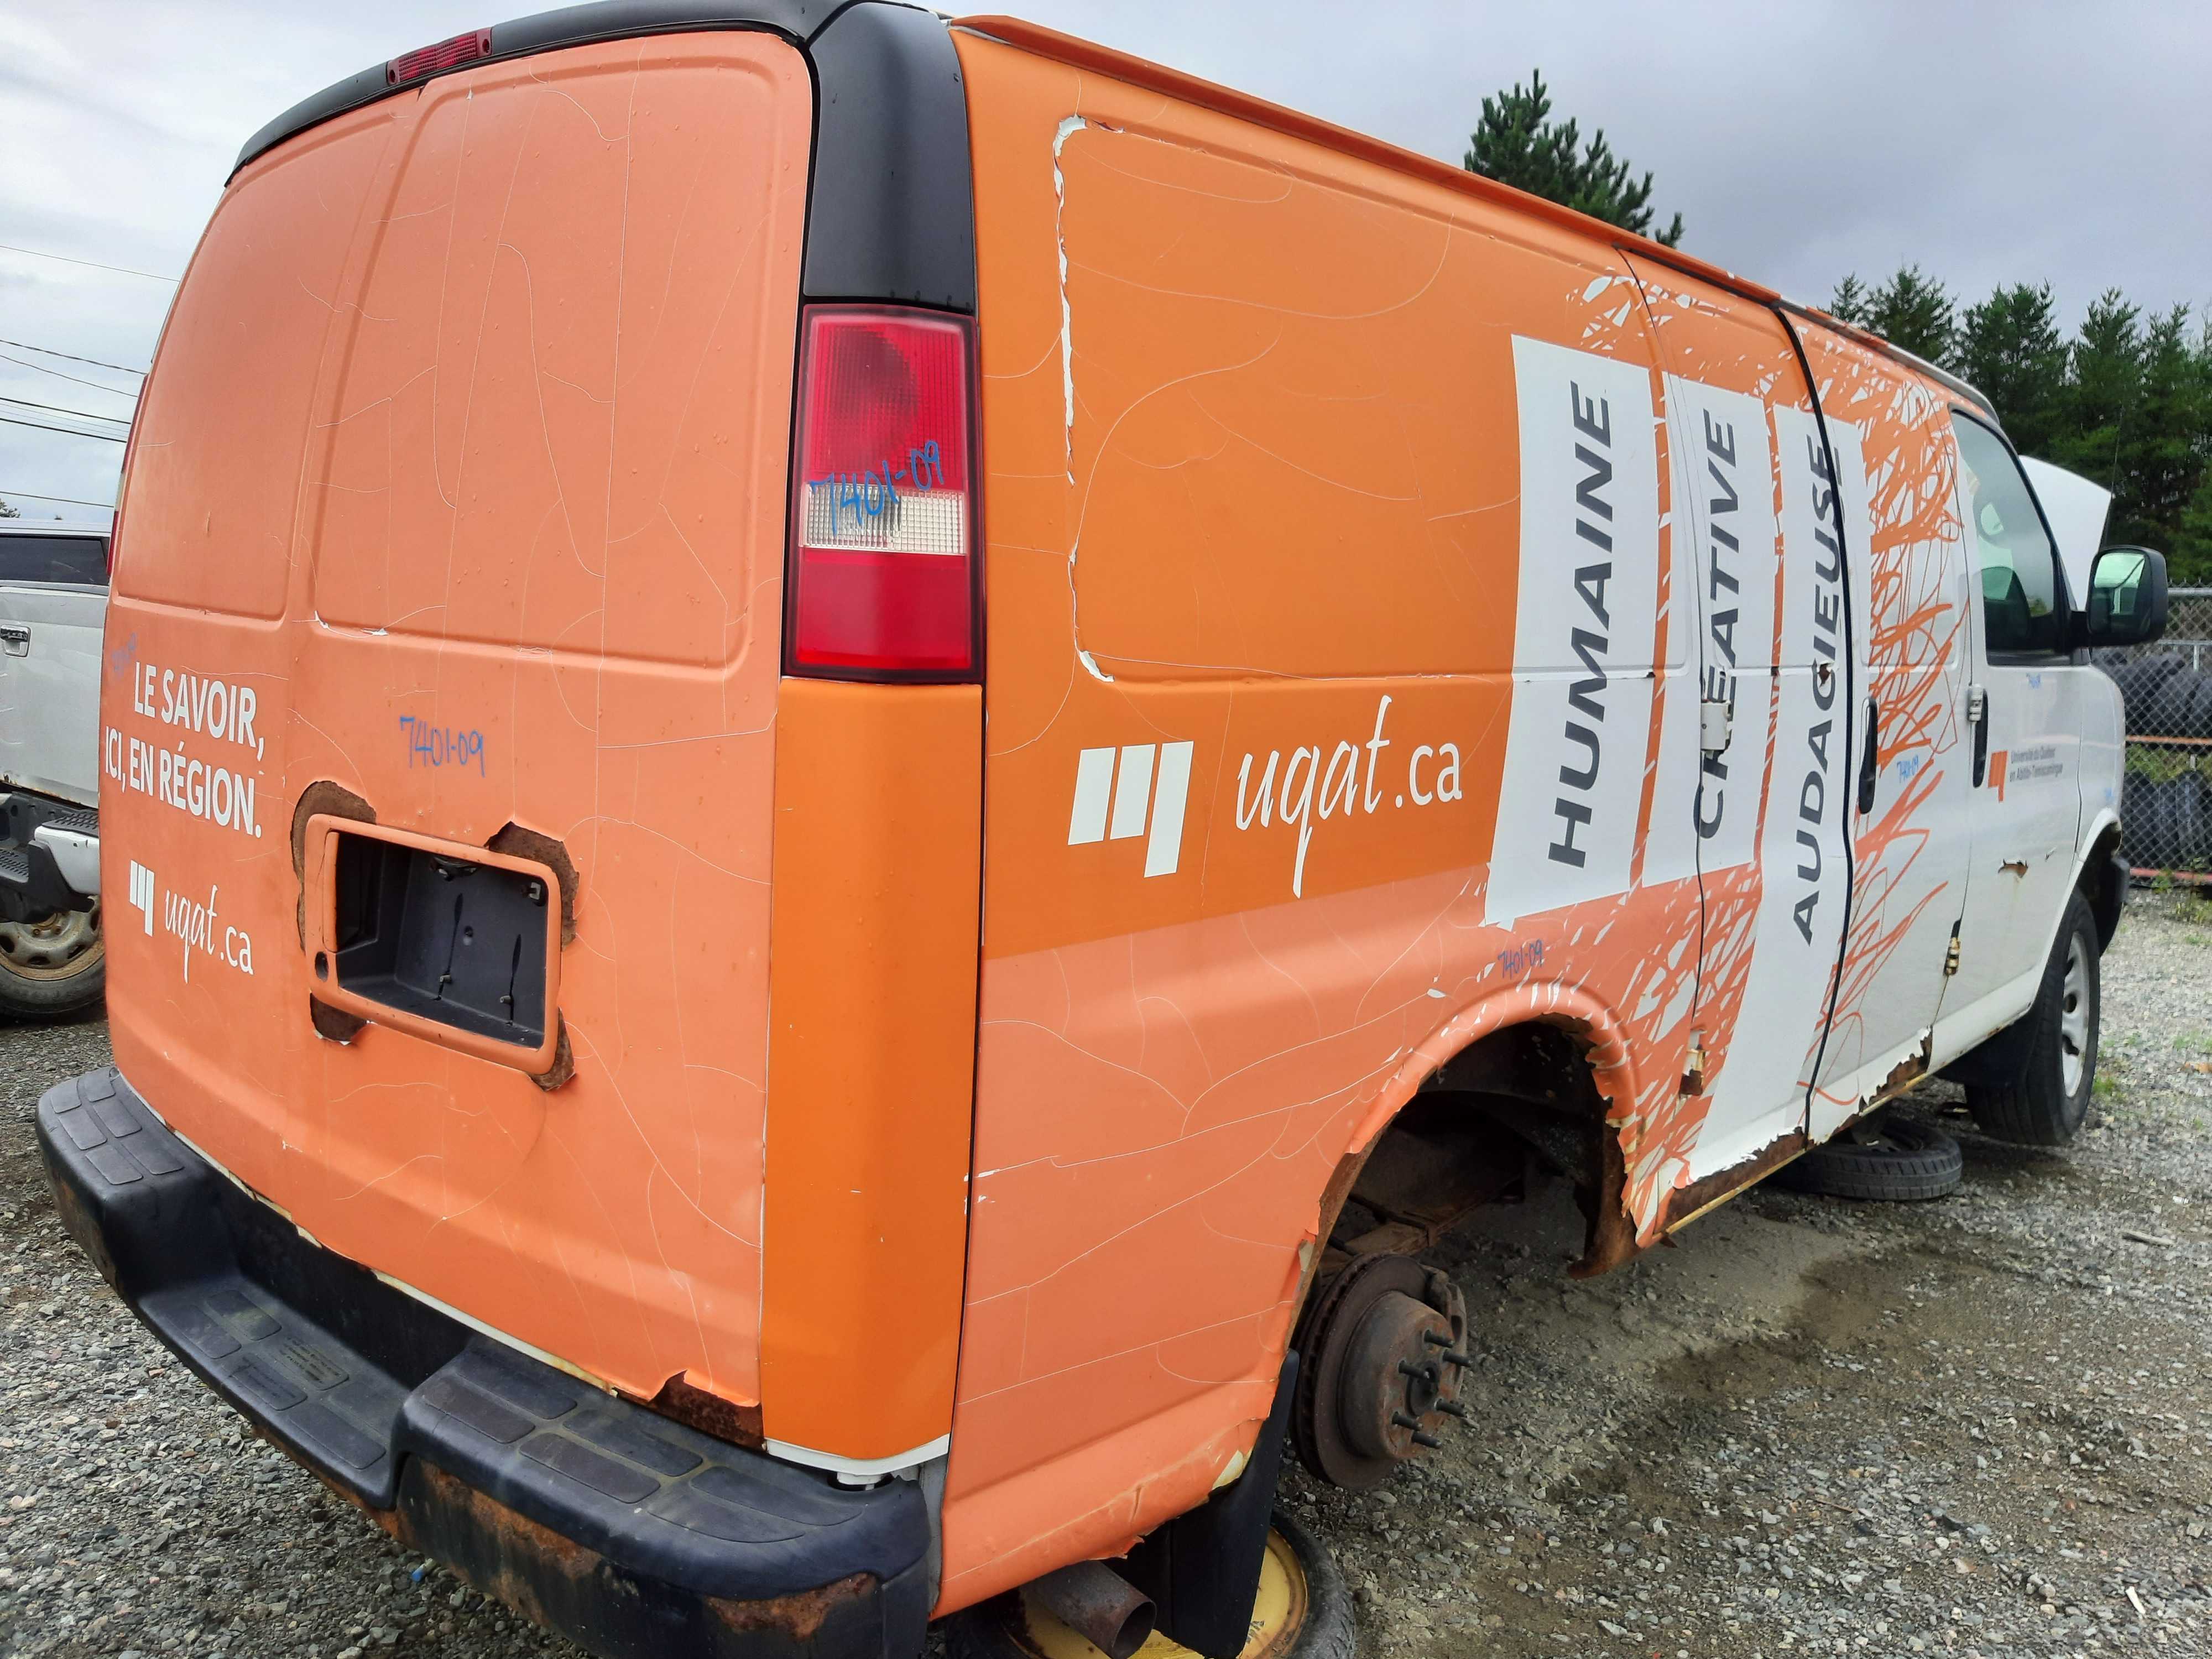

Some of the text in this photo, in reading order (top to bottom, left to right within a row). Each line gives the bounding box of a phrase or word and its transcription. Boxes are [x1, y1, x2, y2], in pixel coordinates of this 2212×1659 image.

[809, 440, 944, 536] 7401-09
[1548, 380, 1614, 869] HUMAINE
[134, 661, 265, 761] LE SAVOIR,
[399, 714, 486, 779] 7401-09
[105, 726, 262, 838] ICI, EN RÉGION.
[1235, 695, 1463, 899] uqat.ca
[165, 884, 254, 984] uqat.ca
[1498, 938, 1543, 980] 7401-09
